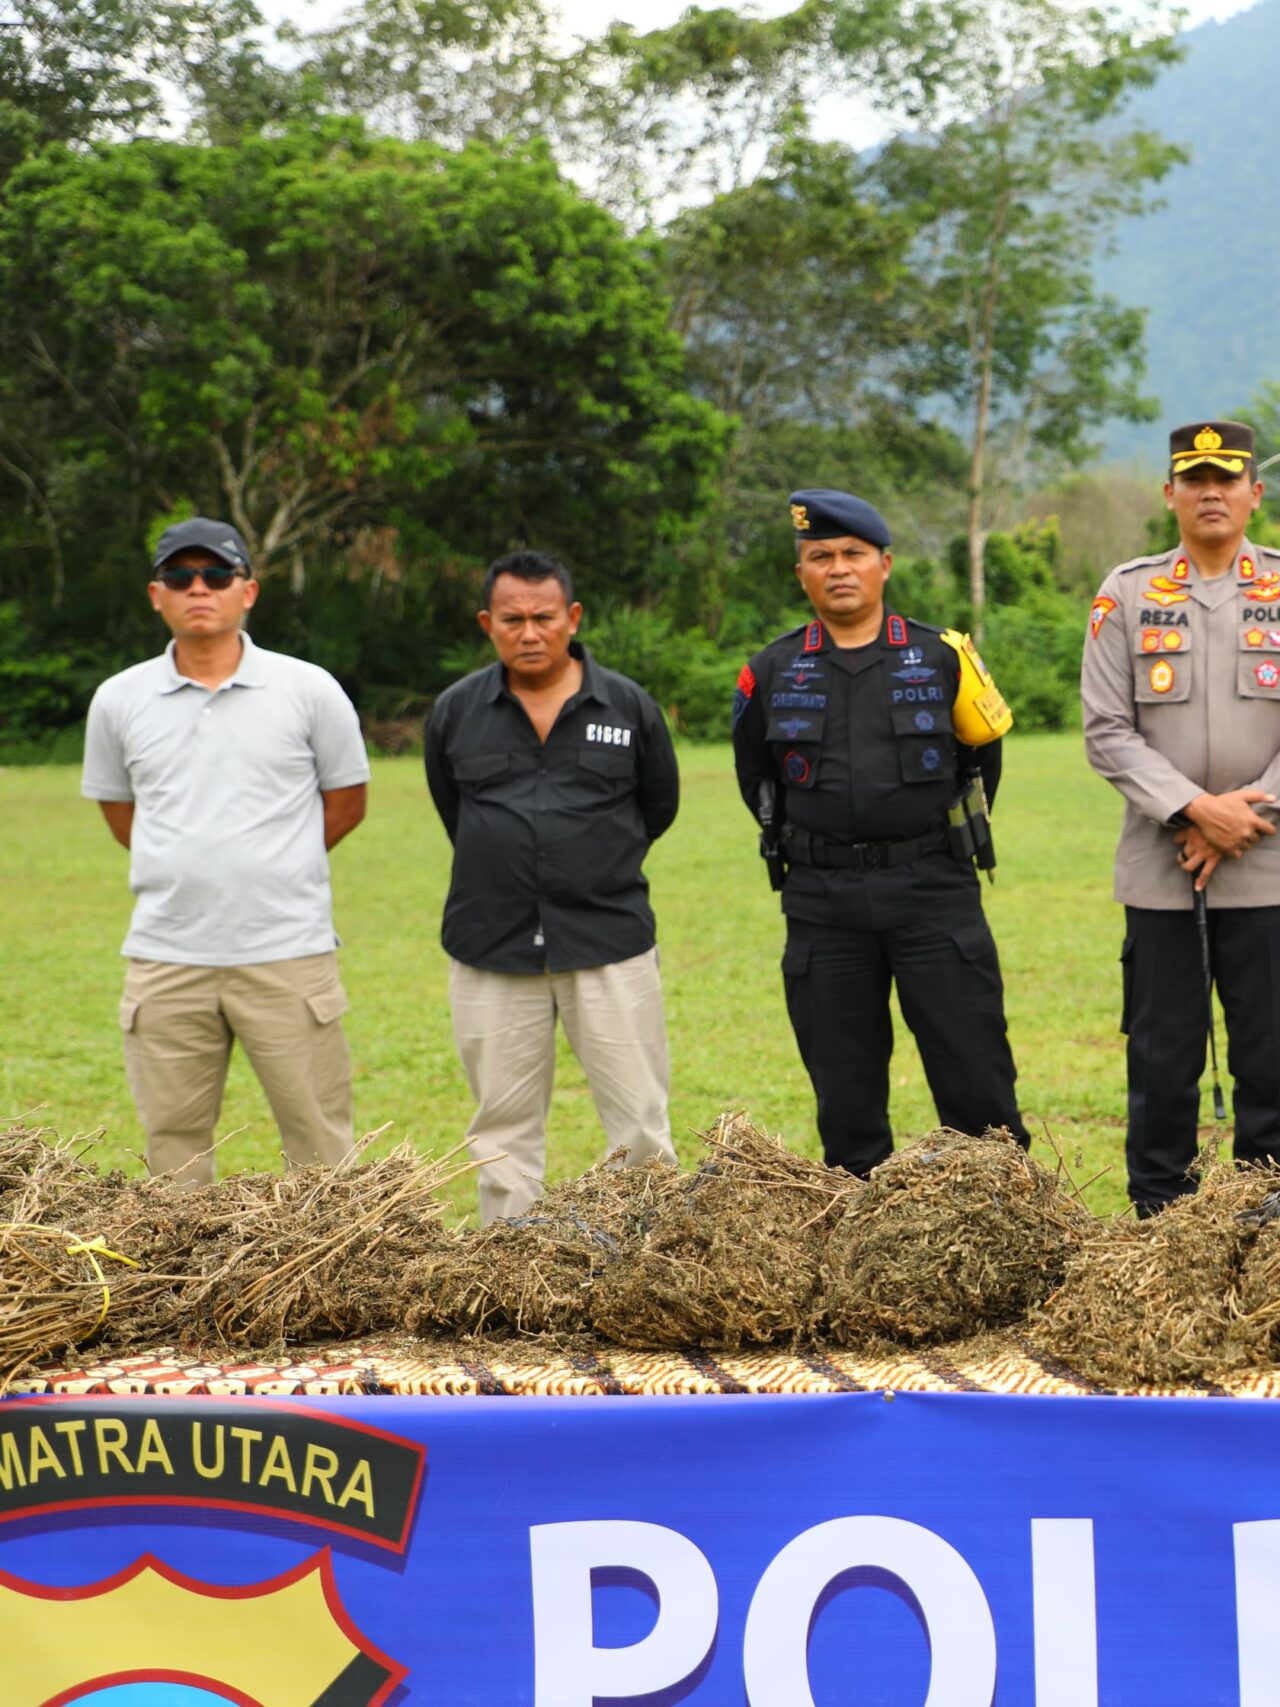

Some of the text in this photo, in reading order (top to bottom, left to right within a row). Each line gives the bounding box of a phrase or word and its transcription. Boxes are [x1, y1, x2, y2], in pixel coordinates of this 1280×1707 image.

[1140, 609, 1189, 627] REZA
[893, 686, 944, 703] POLRI
[192, 1421, 376, 1518] UTARA
